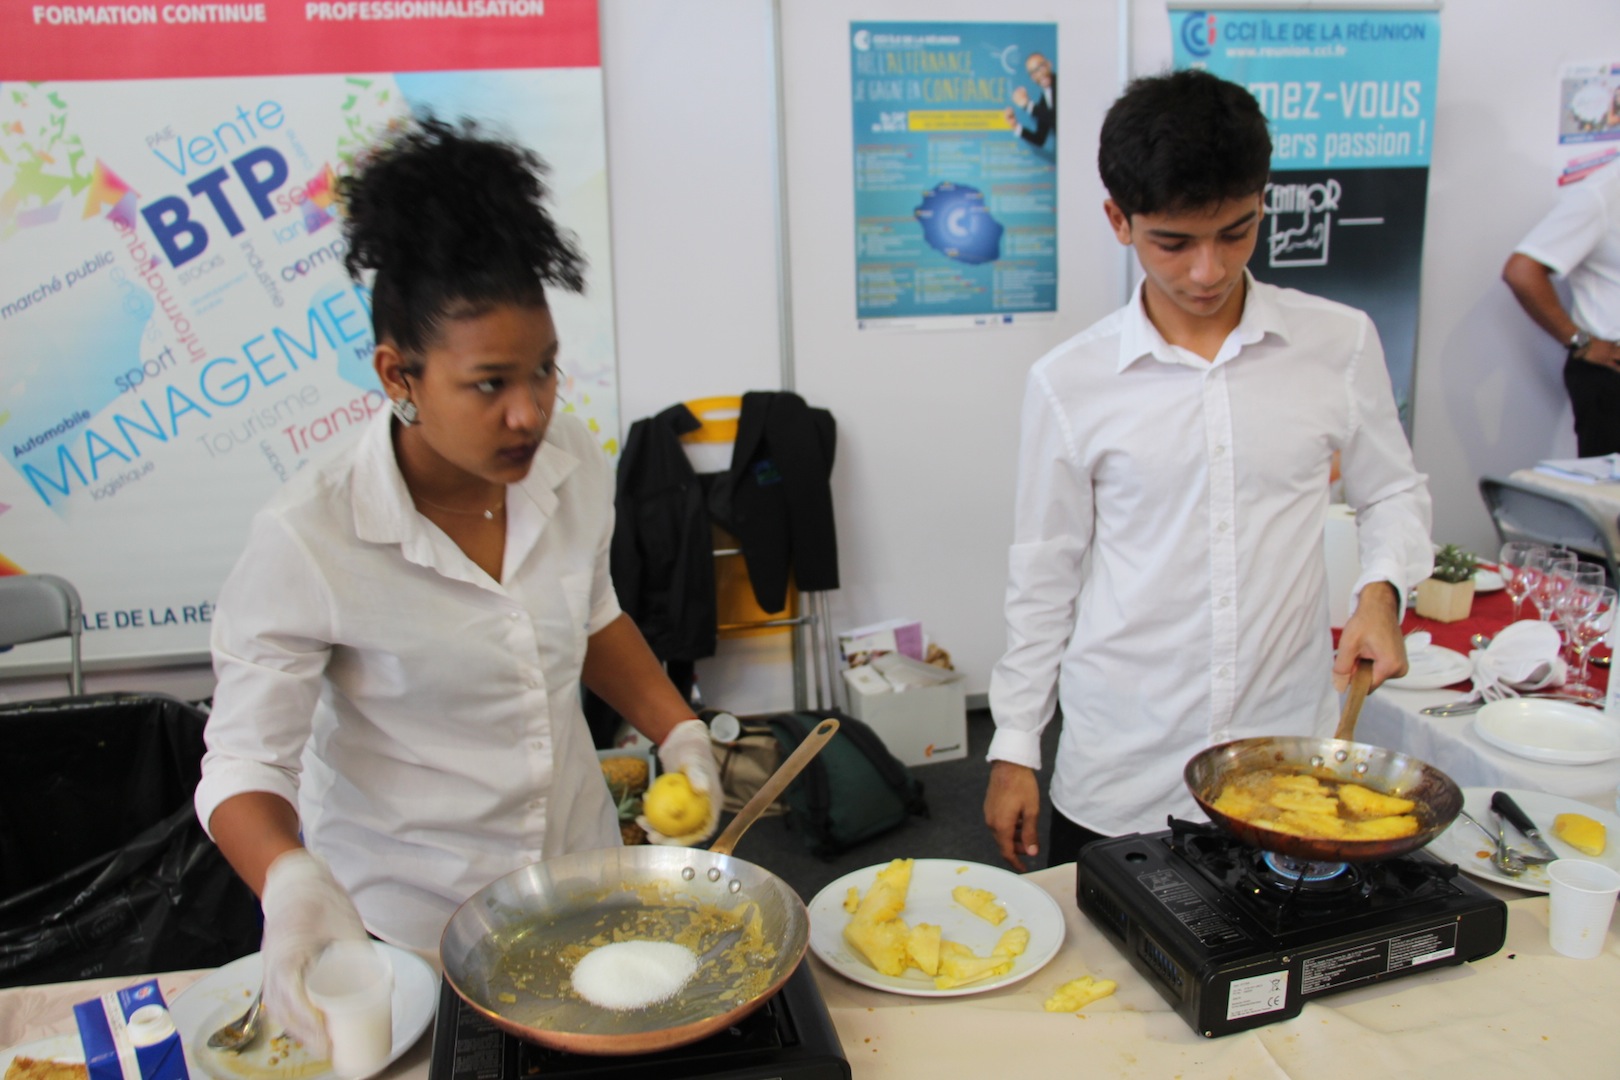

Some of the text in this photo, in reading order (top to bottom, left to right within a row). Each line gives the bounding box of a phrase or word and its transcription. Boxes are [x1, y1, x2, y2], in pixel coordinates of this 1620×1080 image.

[33, 4, 266, 25] FORMATION CONTINUE
[305, 0, 544, 20] PROFESSIONNALISATION
[1224, 18, 1426, 41] CCI ÎLE DE LA RÉUNION
[1249, 80, 1422, 120] mez-vous
[152, 100, 285, 177] Vente
[1272, 124, 1318, 159] iers
[1324, 123, 1411, 166] passion
[140, 146, 289, 269] BTP
[281, 238, 350, 283] comp
[0, 251, 116, 320] marché public
[113, 215, 207, 363] Informatique
[114, 345, 177, 393] sport
[22, 284, 373, 507] MANAGEME
[12, 409, 91, 458] Automobile
[197, 384, 320, 459] Tourisme
[282, 388, 386, 454] Transp
[90, 460, 155, 502] logistique
[82, 600, 216, 631] LE DE LA RÉ
